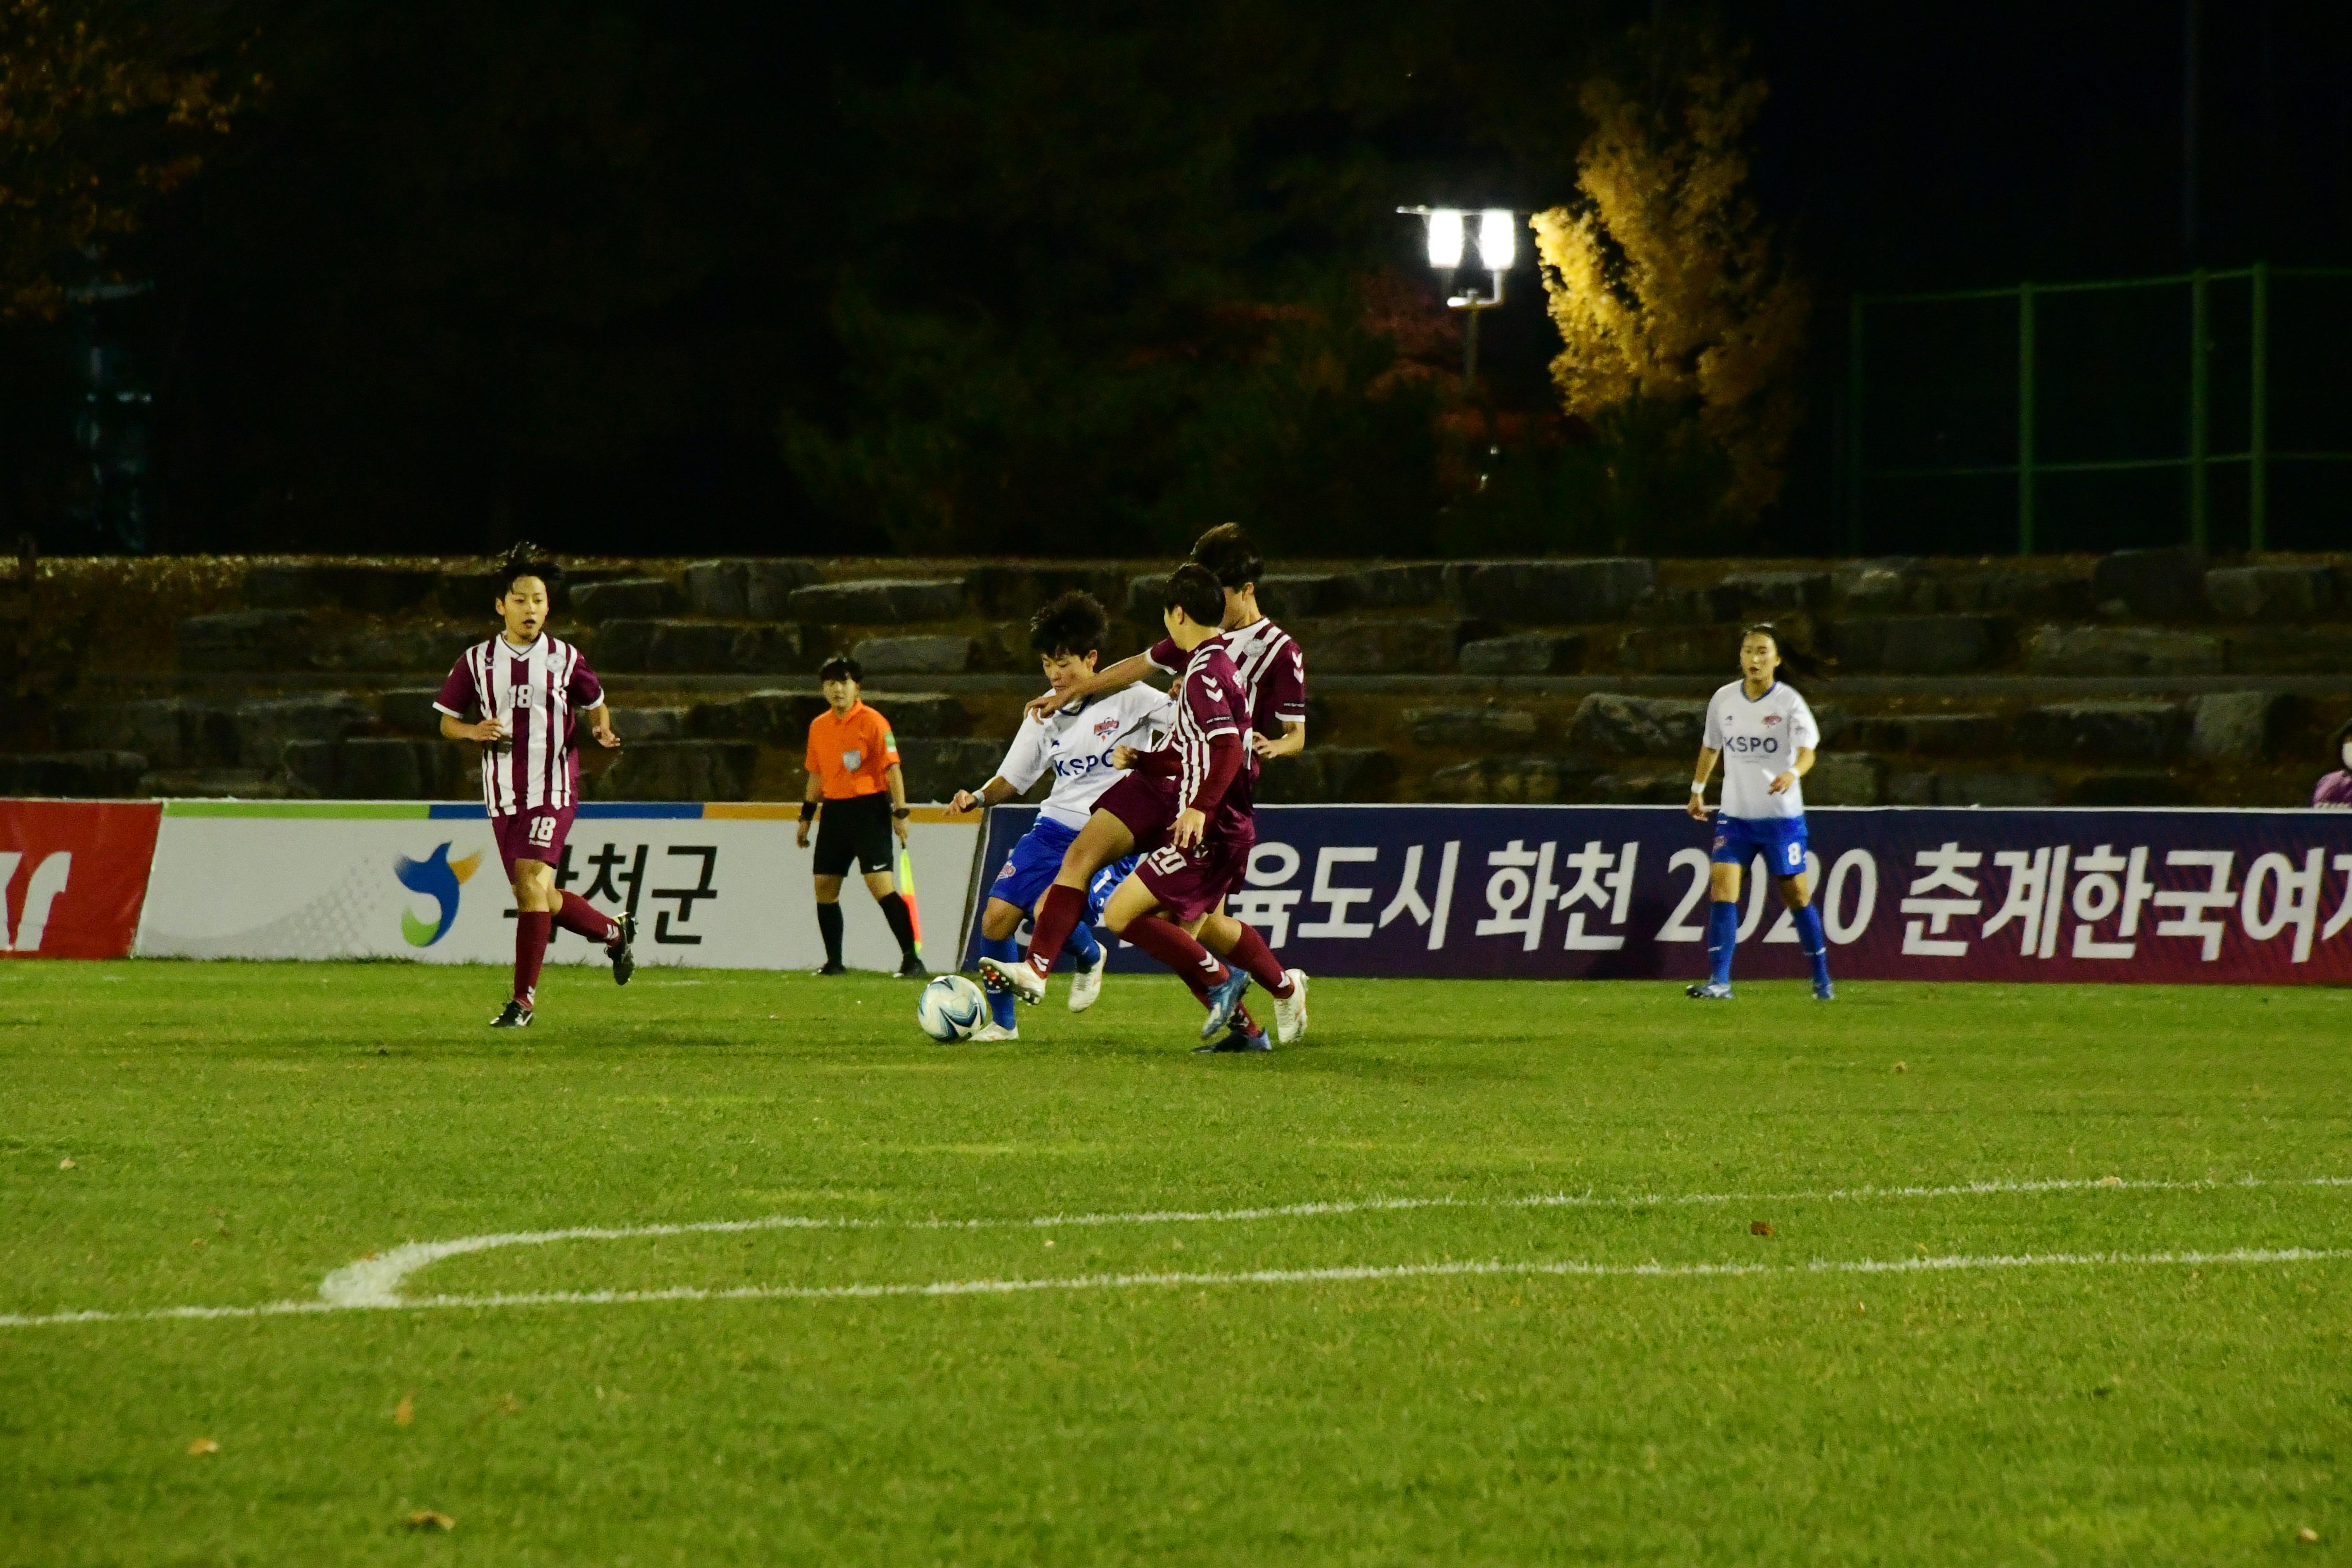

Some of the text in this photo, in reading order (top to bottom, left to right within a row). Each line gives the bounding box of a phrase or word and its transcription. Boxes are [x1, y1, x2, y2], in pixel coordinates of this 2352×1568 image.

[507, 685, 534, 708] 18
[1724, 736, 1778, 753] KSPO
[529, 816, 556, 841] 18
[1151, 843, 1187, 875] 20
[1788, 842, 1802, 866] 8
[1475, 839, 1638, 951] 화천
